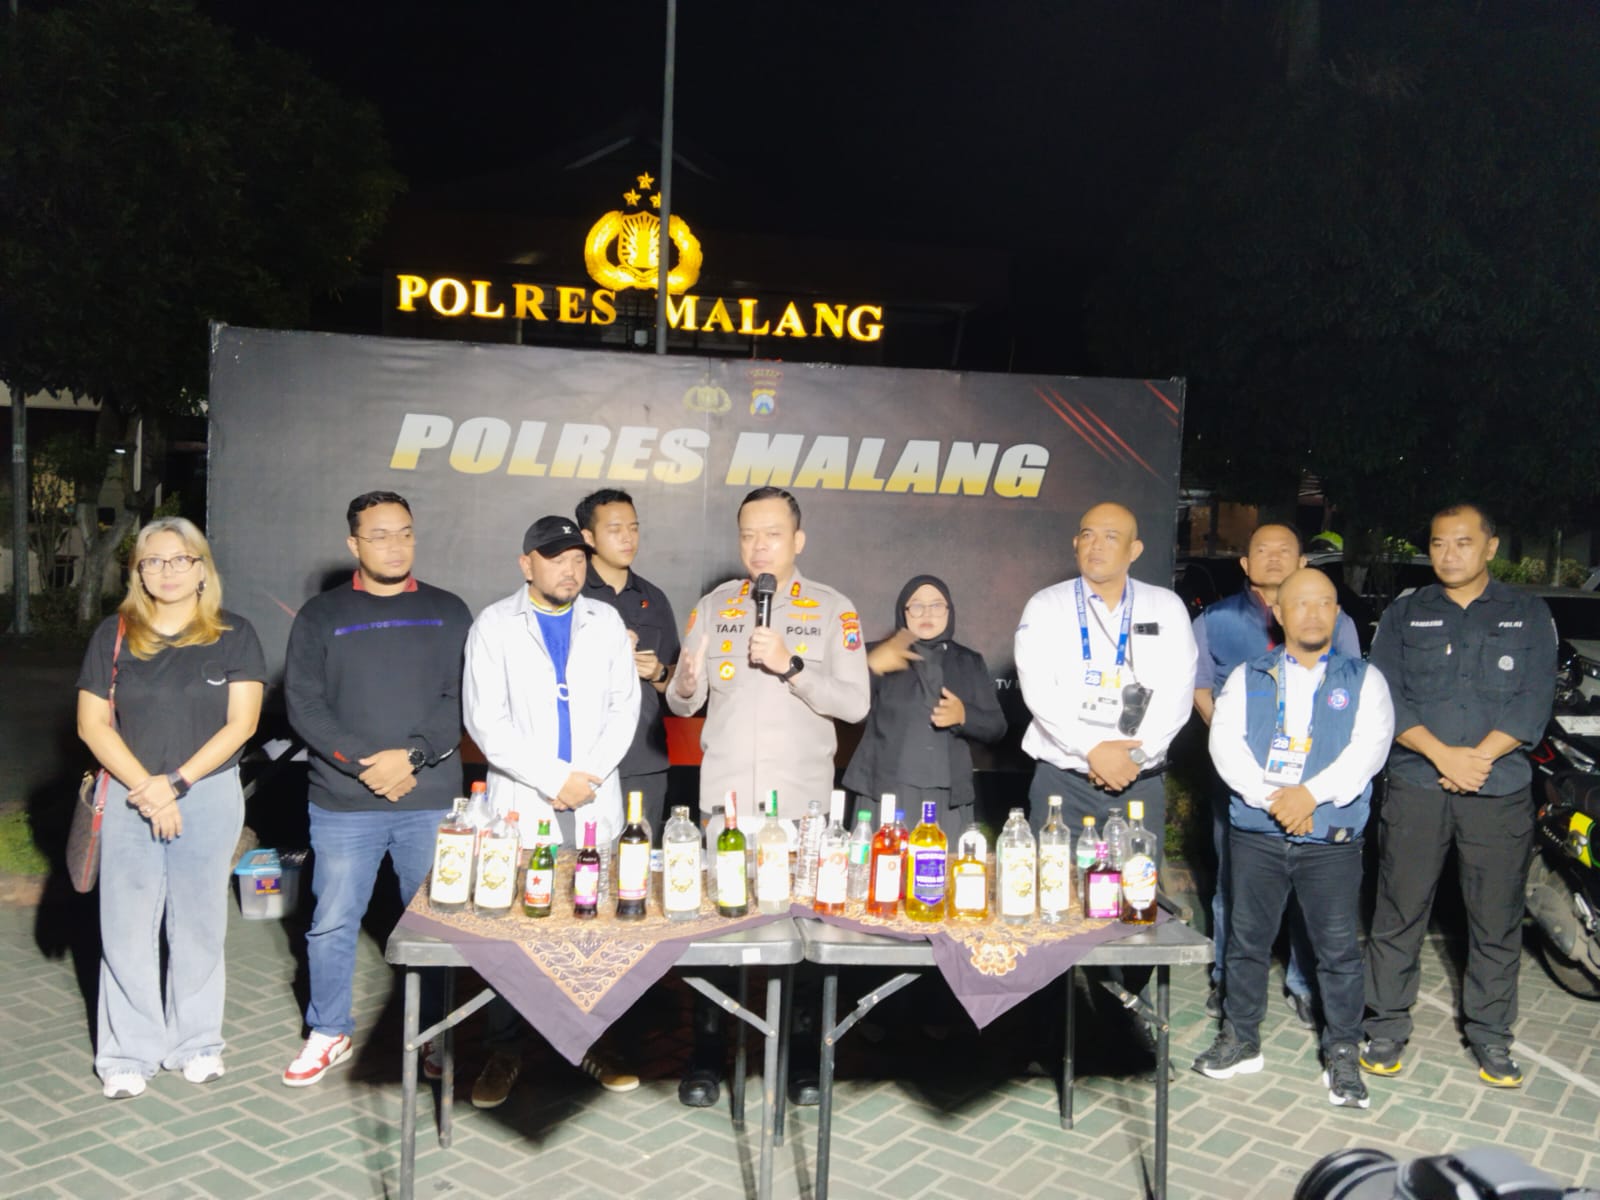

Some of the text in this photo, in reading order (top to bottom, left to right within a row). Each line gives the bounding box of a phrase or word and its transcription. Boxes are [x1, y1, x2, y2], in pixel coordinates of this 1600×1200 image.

[396, 275, 884, 341] POLRES MALANG
[389, 413, 1051, 498] POLRES MALANG
[716, 624, 745, 633] TAAT
[786, 626, 822, 637] POLRI
